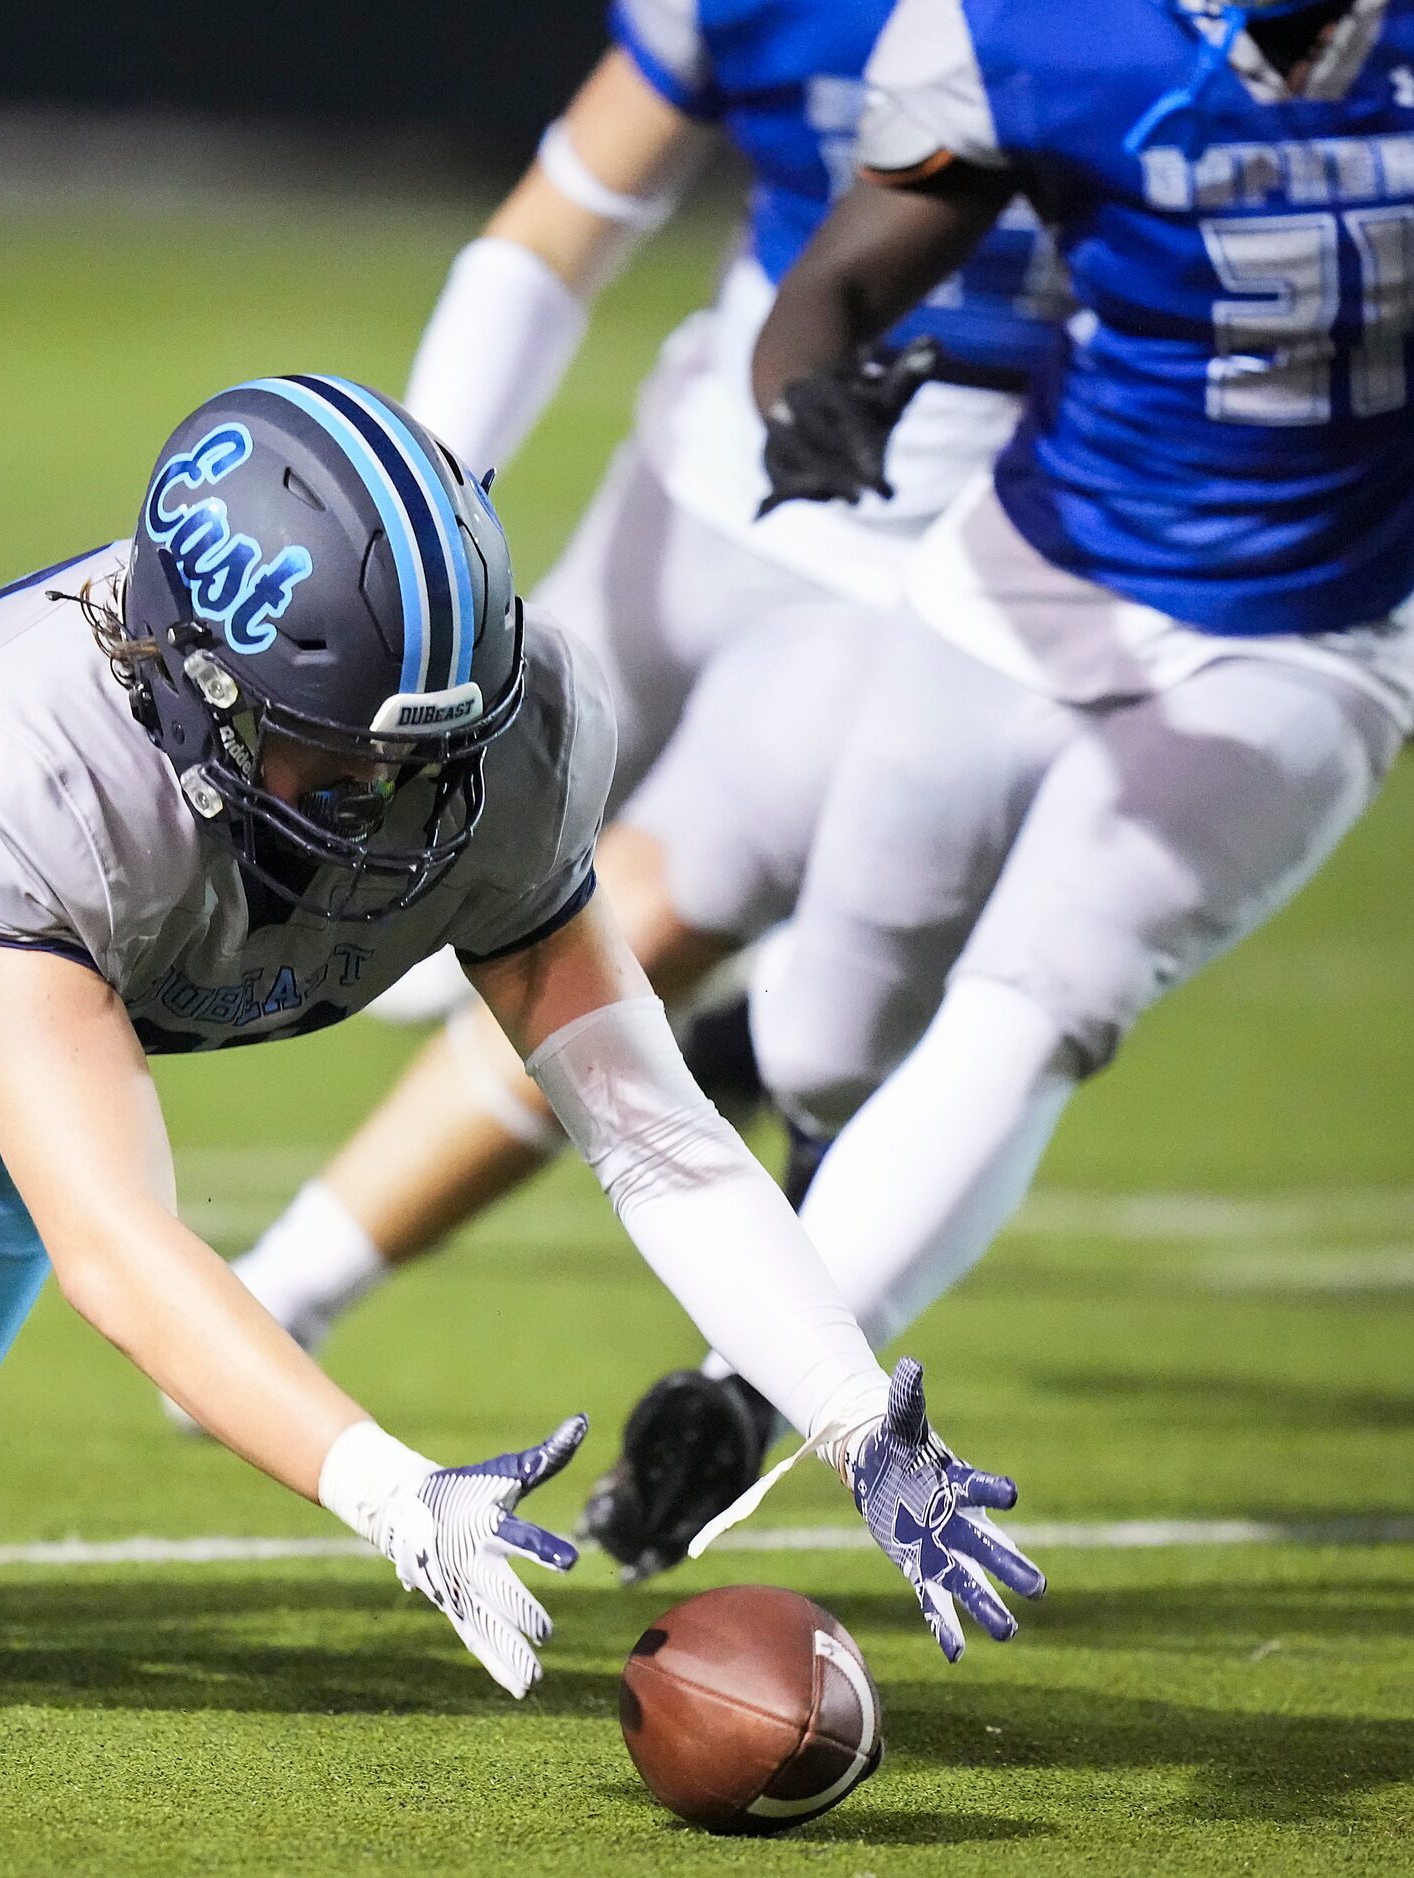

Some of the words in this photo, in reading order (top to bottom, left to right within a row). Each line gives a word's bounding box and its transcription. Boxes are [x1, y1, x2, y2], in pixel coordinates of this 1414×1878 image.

[146, 422, 312, 654] East
[396, 697, 476, 727] DUBEAST
[219, 725, 253, 778] Ridde
